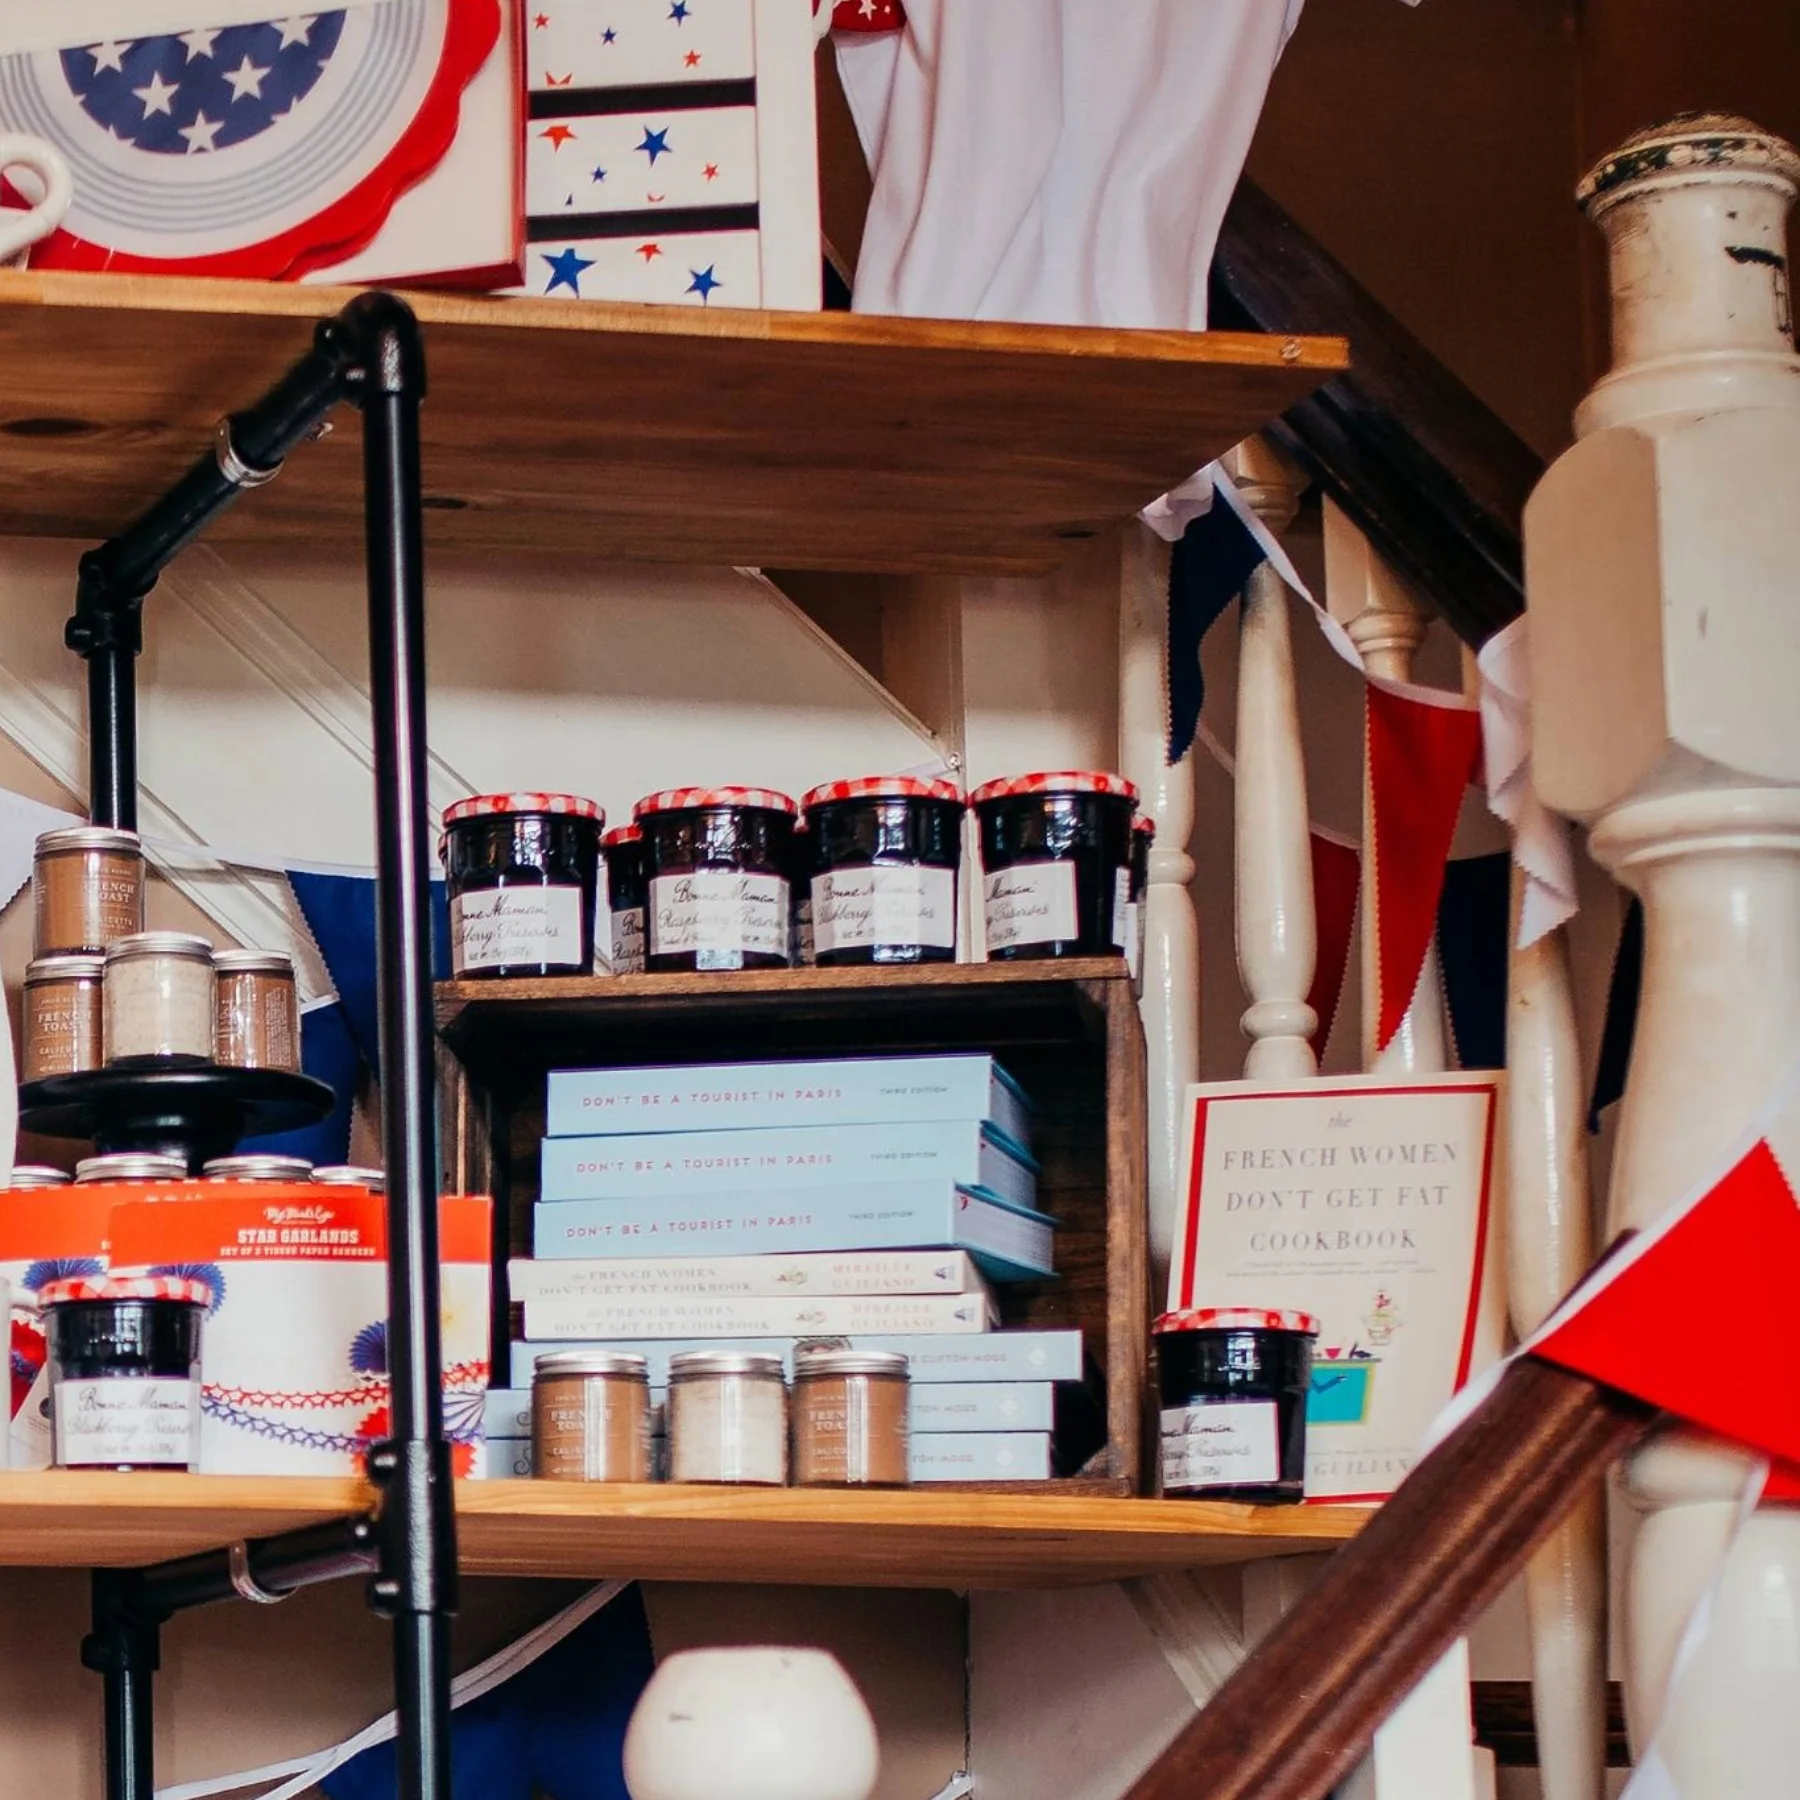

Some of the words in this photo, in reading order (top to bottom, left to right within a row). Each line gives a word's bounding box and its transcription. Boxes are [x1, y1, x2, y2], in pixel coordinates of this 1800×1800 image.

[583, 1095, 631, 1107] DON'T
[641, 1095, 660, 1105] BE
[671, 1094, 680, 1103] A
[691, 1091, 758, 1103] TOURIST
[768, 1090, 784, 1100] IN
[795, 1089, 842, 1099] PARIS
[1327, 1111, 1353, 1130] the
[576, 1161, 625, 1173] DON'T
[634, 1160, 654, 1171] BE
[664, 1159, 674, 1169] A
[683, 1157, 750, 1169] TOURIST
[760, 1156, 777, 1166] IN
[786, 1154, 833, 1165] PARIS
[1224, 1147, 1338, 1171] FRENCH
[1349, 1143, 1460, 1167] WOMEN
[1226, 1189, 1314, 1212] DON'T
[1326, 1188, 1385, 1209] GET
[1397, 1185, 1451, 1207] FAT
[566, 1226, 612, 1238] DON'T
[621, 1225, 640, 1235] BE
[649, 1224, 658, 1233] A
[669, 1219, 733, 1231] TOURIST
[742, 1218, 758, 1228] IN
[767, 1214, 813, 1226] PARIS
[238, 1228, 276, 1244] STAR
[280, 1228, 359, 1245] GARLANDS
[1250, 1229, 1417, 1253] COOKBOOK
[589, 1268, 652, 1281] FRENCH
[657, 1268, 717, 1279] WOMEN
[832, 1277, 915, 1290] GUILIANO
[539, 1285, 587, 1297] DON'T
[591, 1284, 623, 1295] GET
[627, 1283, 659, 1294] FAT
[663, 1281, 752, 1294] COOKBOOK
[605, 1306, 667, 1318] FRENCH
[673, 1304, 734, 1316] WOMEN
[608, 1321, 640, 1333] GET
[646, 1320, 678, 1332] FAT
[681, 1319, 770, 1332] COOKBOOK
[1313, 1459, 1411, 1477] GUILIAN
